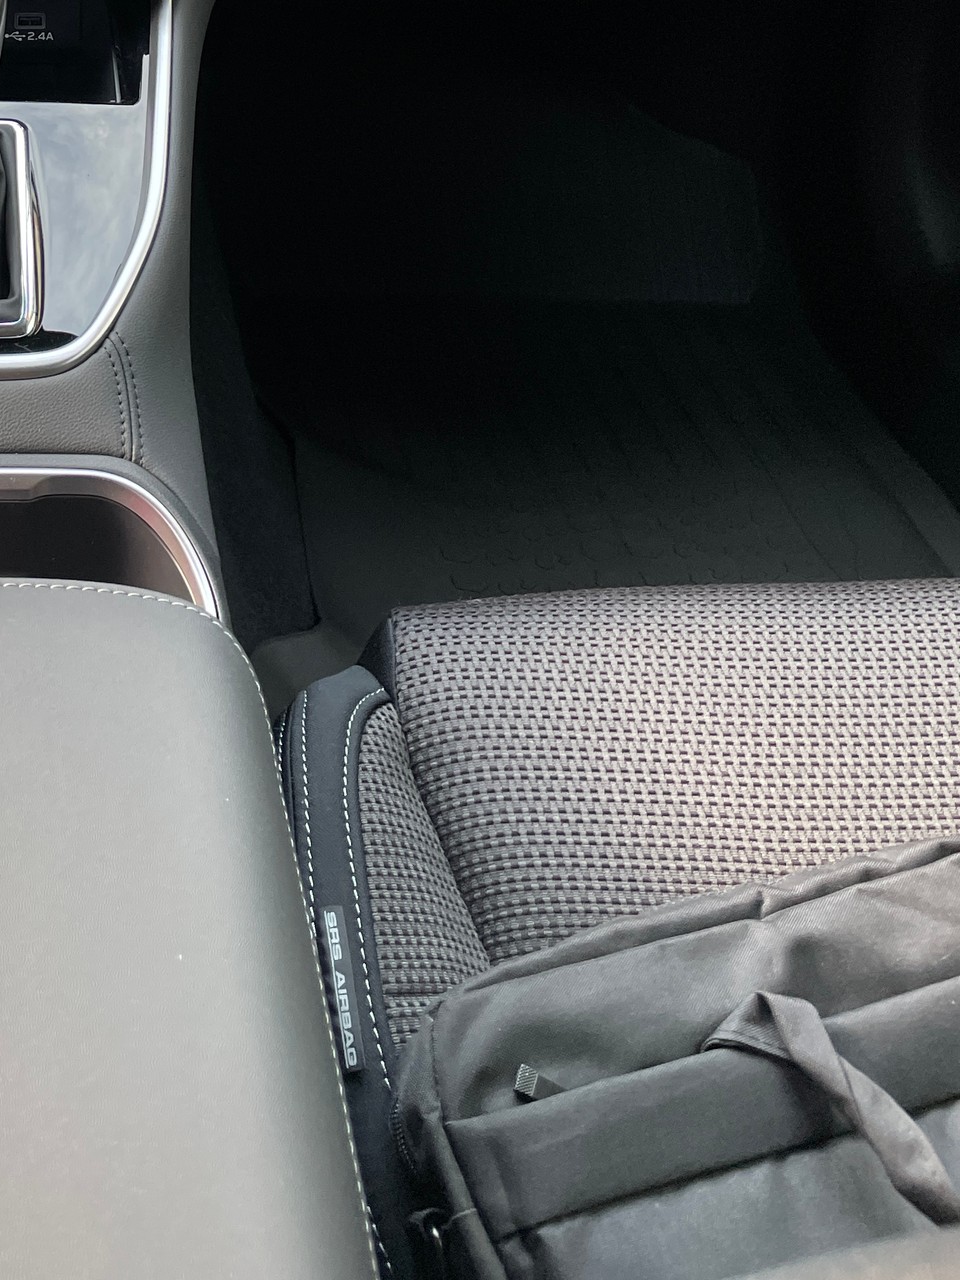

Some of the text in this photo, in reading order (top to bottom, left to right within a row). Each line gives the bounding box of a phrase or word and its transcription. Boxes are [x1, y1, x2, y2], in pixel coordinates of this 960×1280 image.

[27, 31, 54, 41] 2.4A
[326, 910, 358, 1067] SRS AIRBAG
